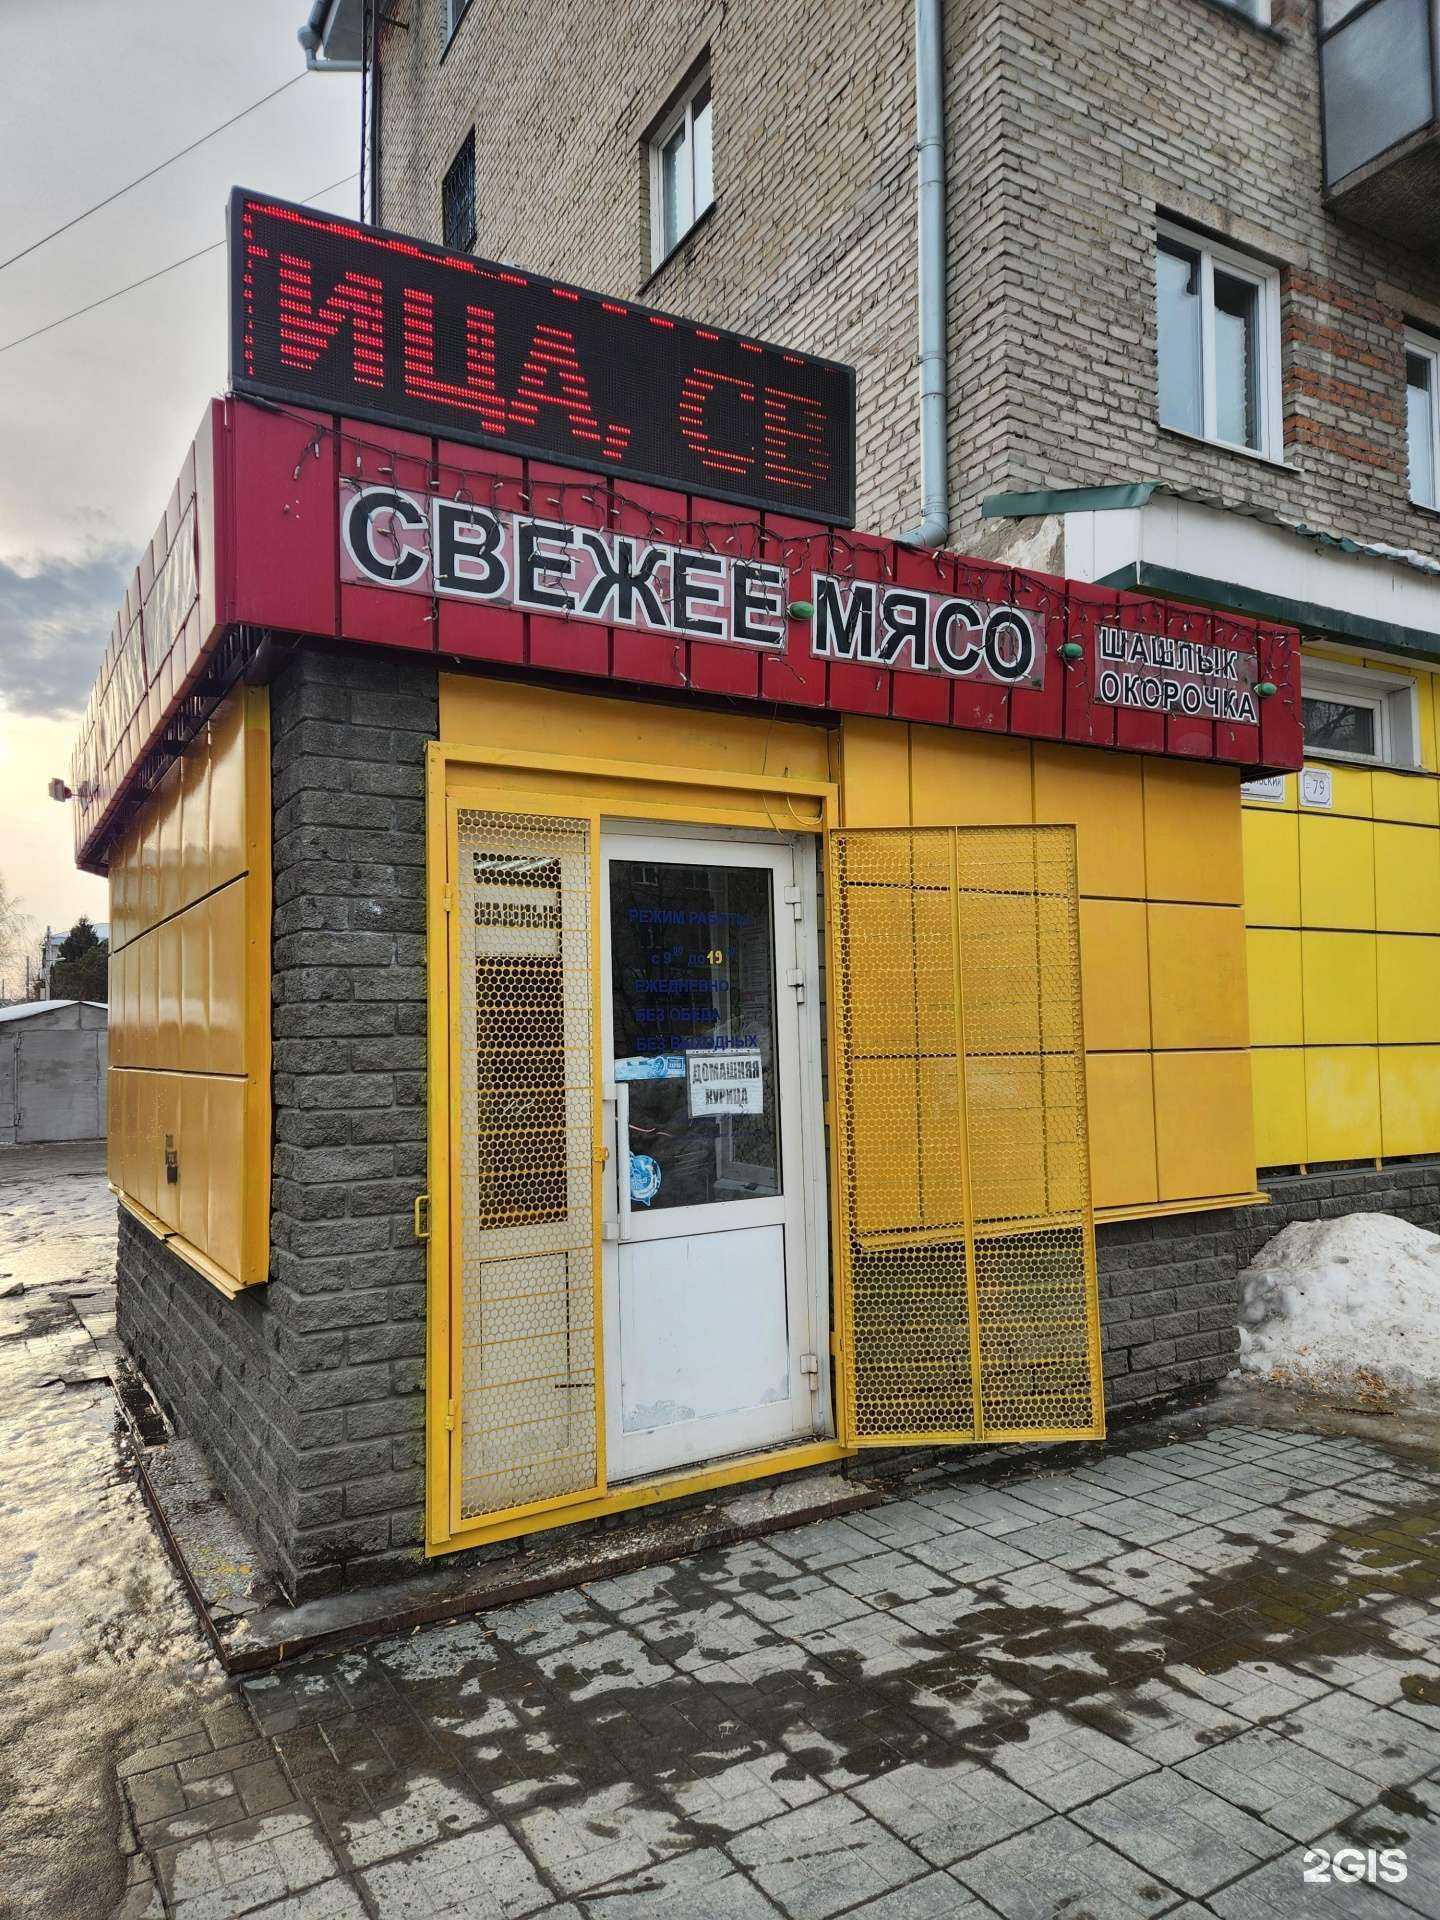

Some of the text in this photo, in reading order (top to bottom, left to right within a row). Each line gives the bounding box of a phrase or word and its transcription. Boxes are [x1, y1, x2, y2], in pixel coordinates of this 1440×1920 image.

[678, 366, 829, 490] СВ
[342, 486, 786, 648] СВЕЖЕЕ
[811, 570, 1036, 683] МЯСО
[1100, 626, 1239, 681] ШАШЛЫК
[1100, 670, 1258, 723] ОКОРОЧКА
[1312, 779, 1325, 795] 79
[628, 909, 684, 924] РЕЖИМ
[635, 979, 730, 992] ЕЖЕДНЕВНО
[635, 1007, 721, 1021] БЕЗ ОБЕДА
[692, 1060, 761, 1084] ДОМАШНЯЯ
